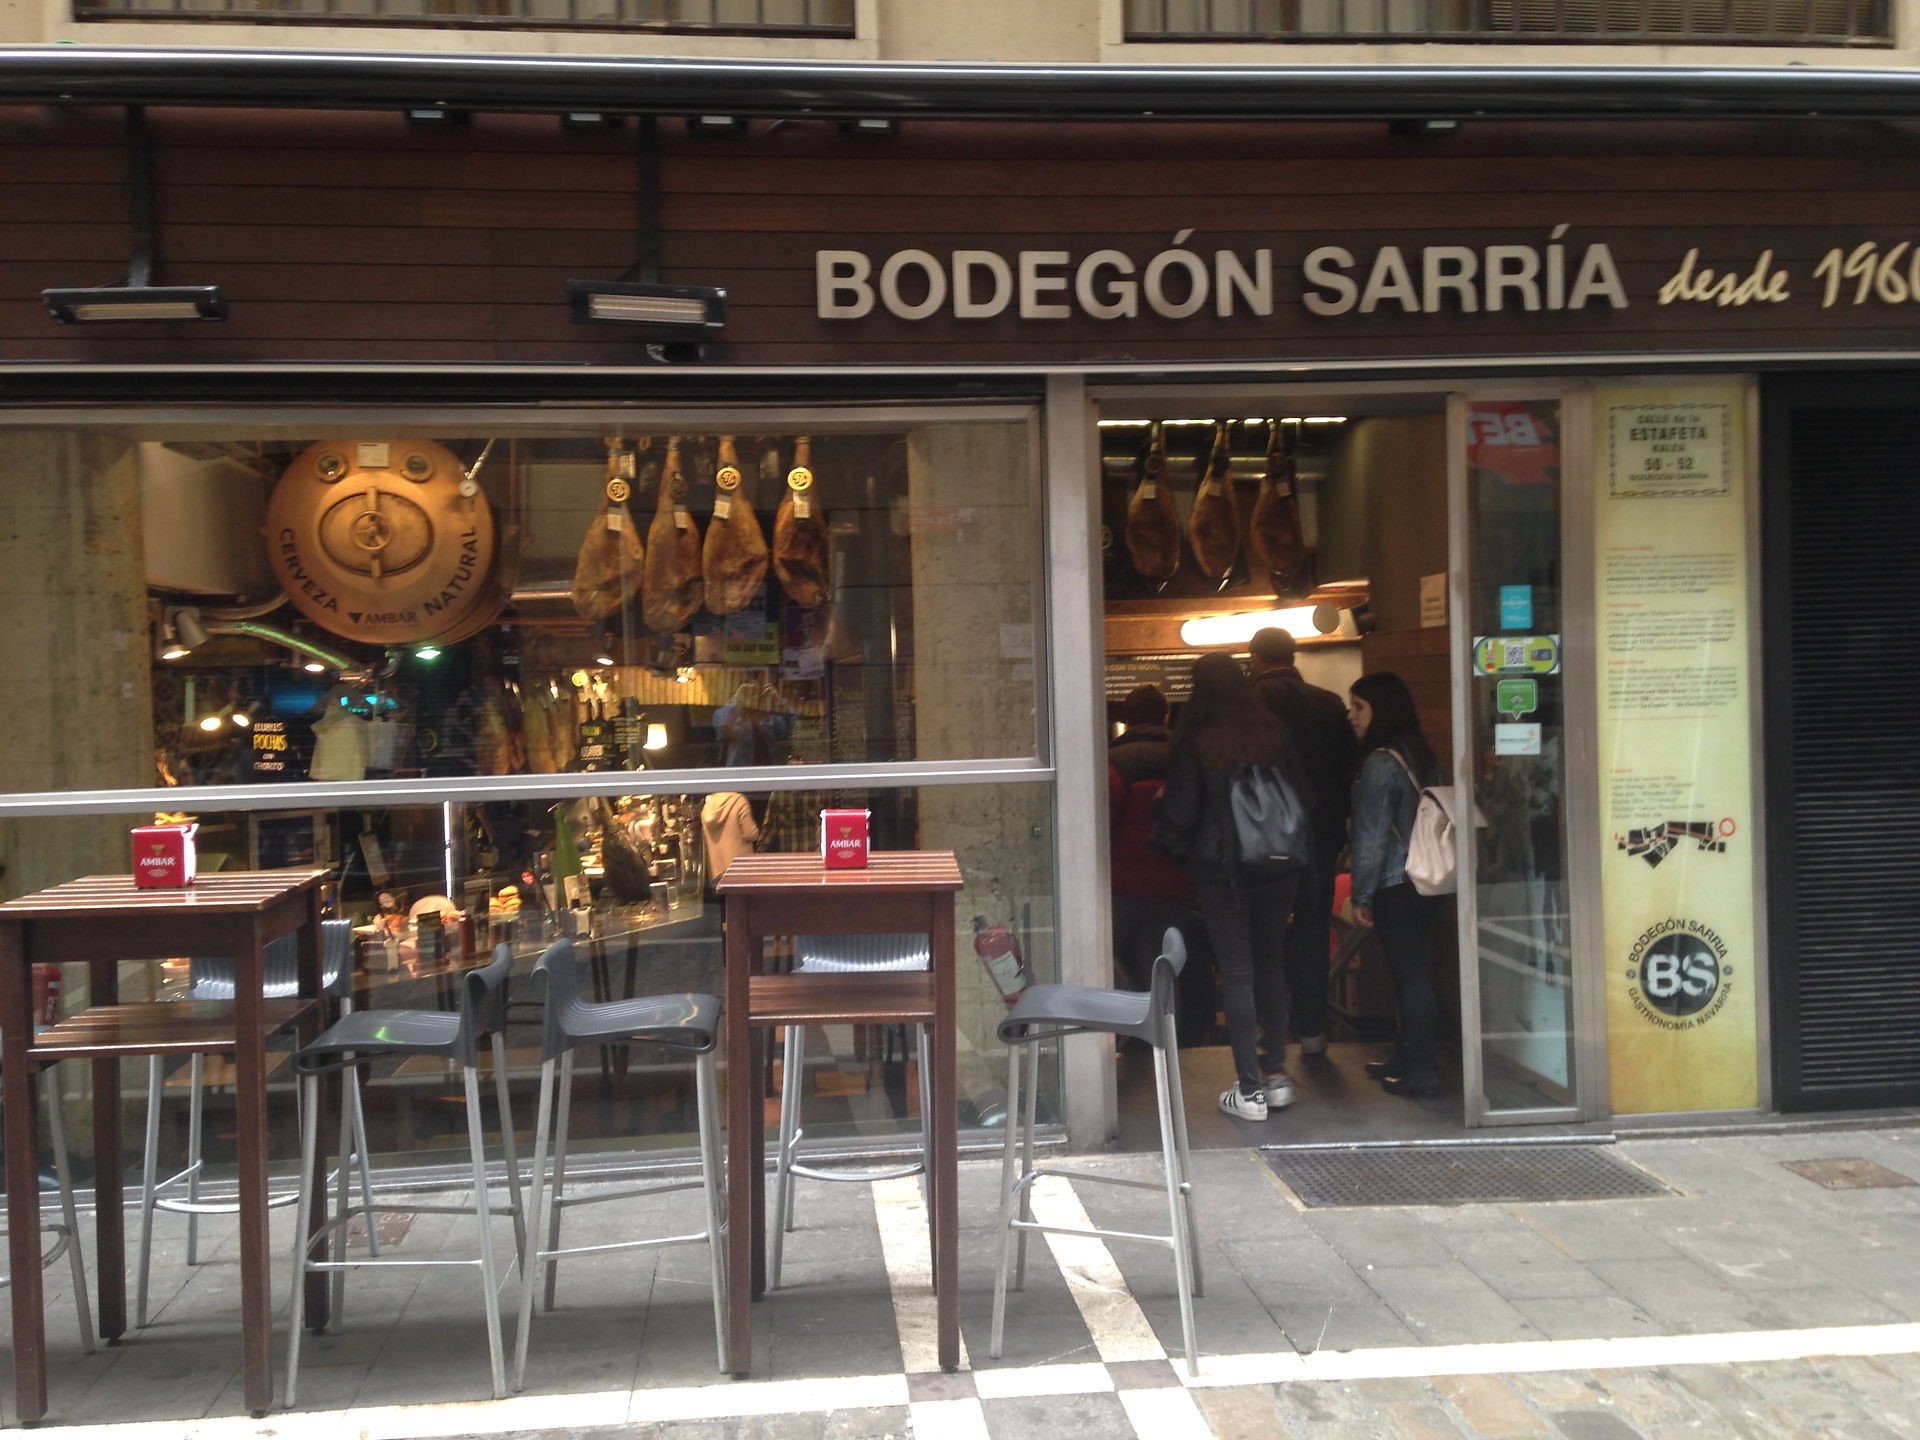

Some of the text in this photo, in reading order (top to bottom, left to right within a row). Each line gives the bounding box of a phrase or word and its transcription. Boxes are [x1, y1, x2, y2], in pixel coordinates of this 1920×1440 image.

[816, 228, 1273, 320] BODEGÓN
[1302, 223, 1628, 316] SARRÍA
[1657, 247, 1791, 307] desde
[1629, 427, 1707, 441] ESTAFETA
[280, 527, 338, 613] CERVEZA
[424, 526, 479, 616] NATURAL
[365, 611, 417, 624] AMBAR
[253, 734, 288, 751] POCHAS
[140, 857, 175, 866] AMBAR
[830, 839, 862, 848] AMBAR
[1628, 916, 1686, 963] BODEGÓN
[1647, 952, 1716, 998] BS
[1697, 982, 1733, 1026] NAVARRA
